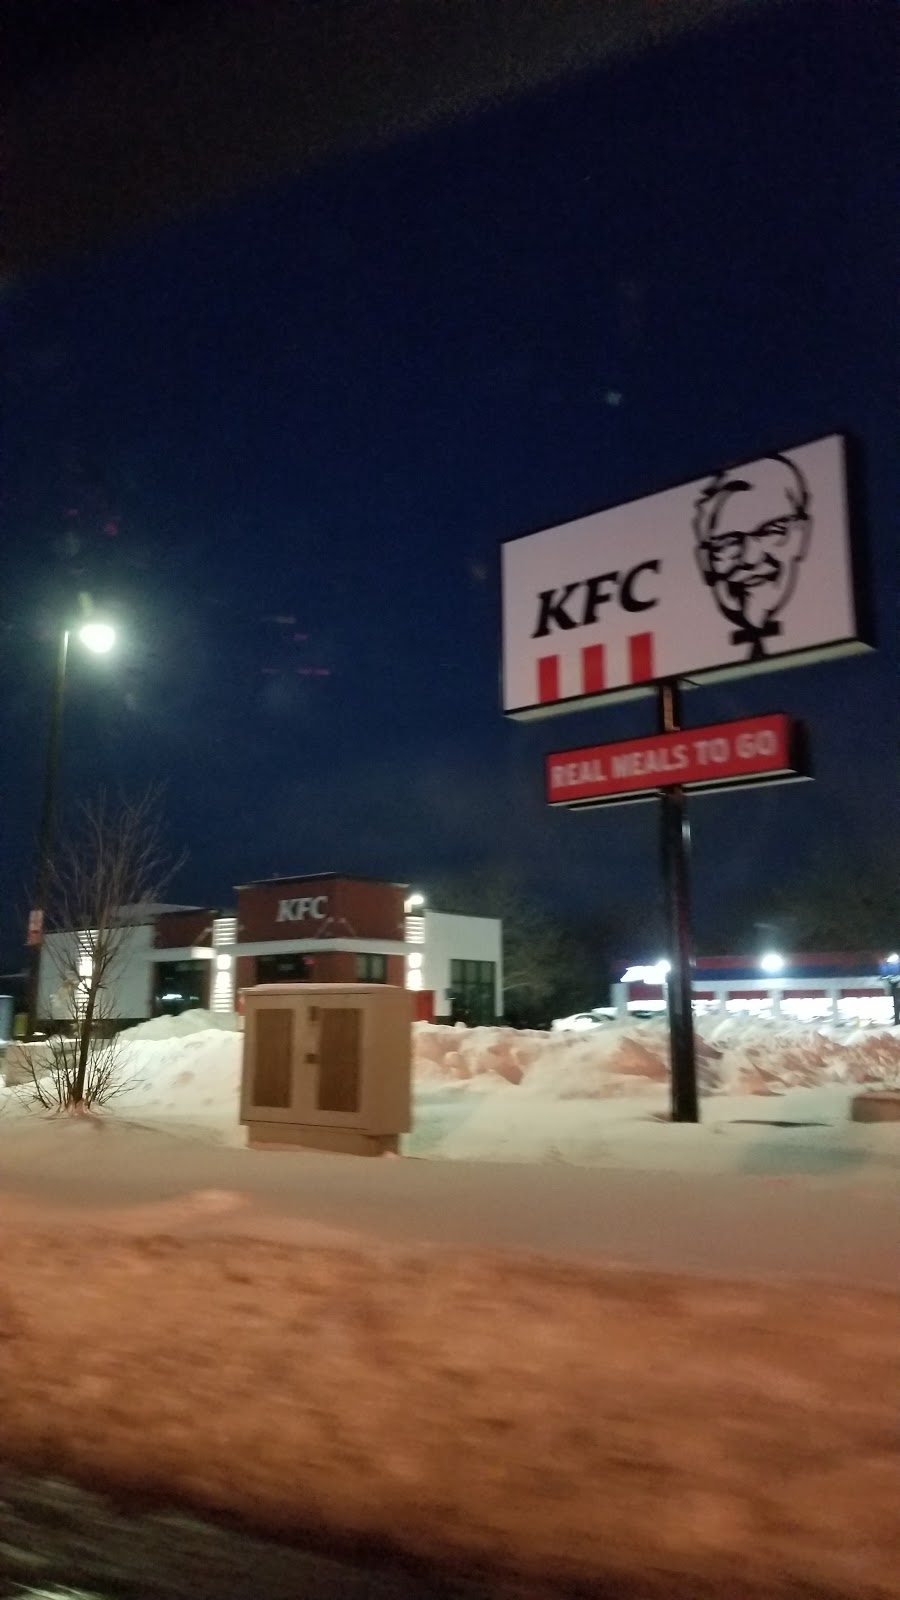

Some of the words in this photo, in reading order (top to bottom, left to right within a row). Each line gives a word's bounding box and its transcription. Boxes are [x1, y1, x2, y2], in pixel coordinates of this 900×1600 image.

[532, 559, 661, 638] KFC
[550, 759, 607, 788] REAL
[610, 744, 689, 779] MEALS
[692, 737, 730, 765] TO
[735, 729, 778, 758] GO
[275, 896, 329, 922] KFC
